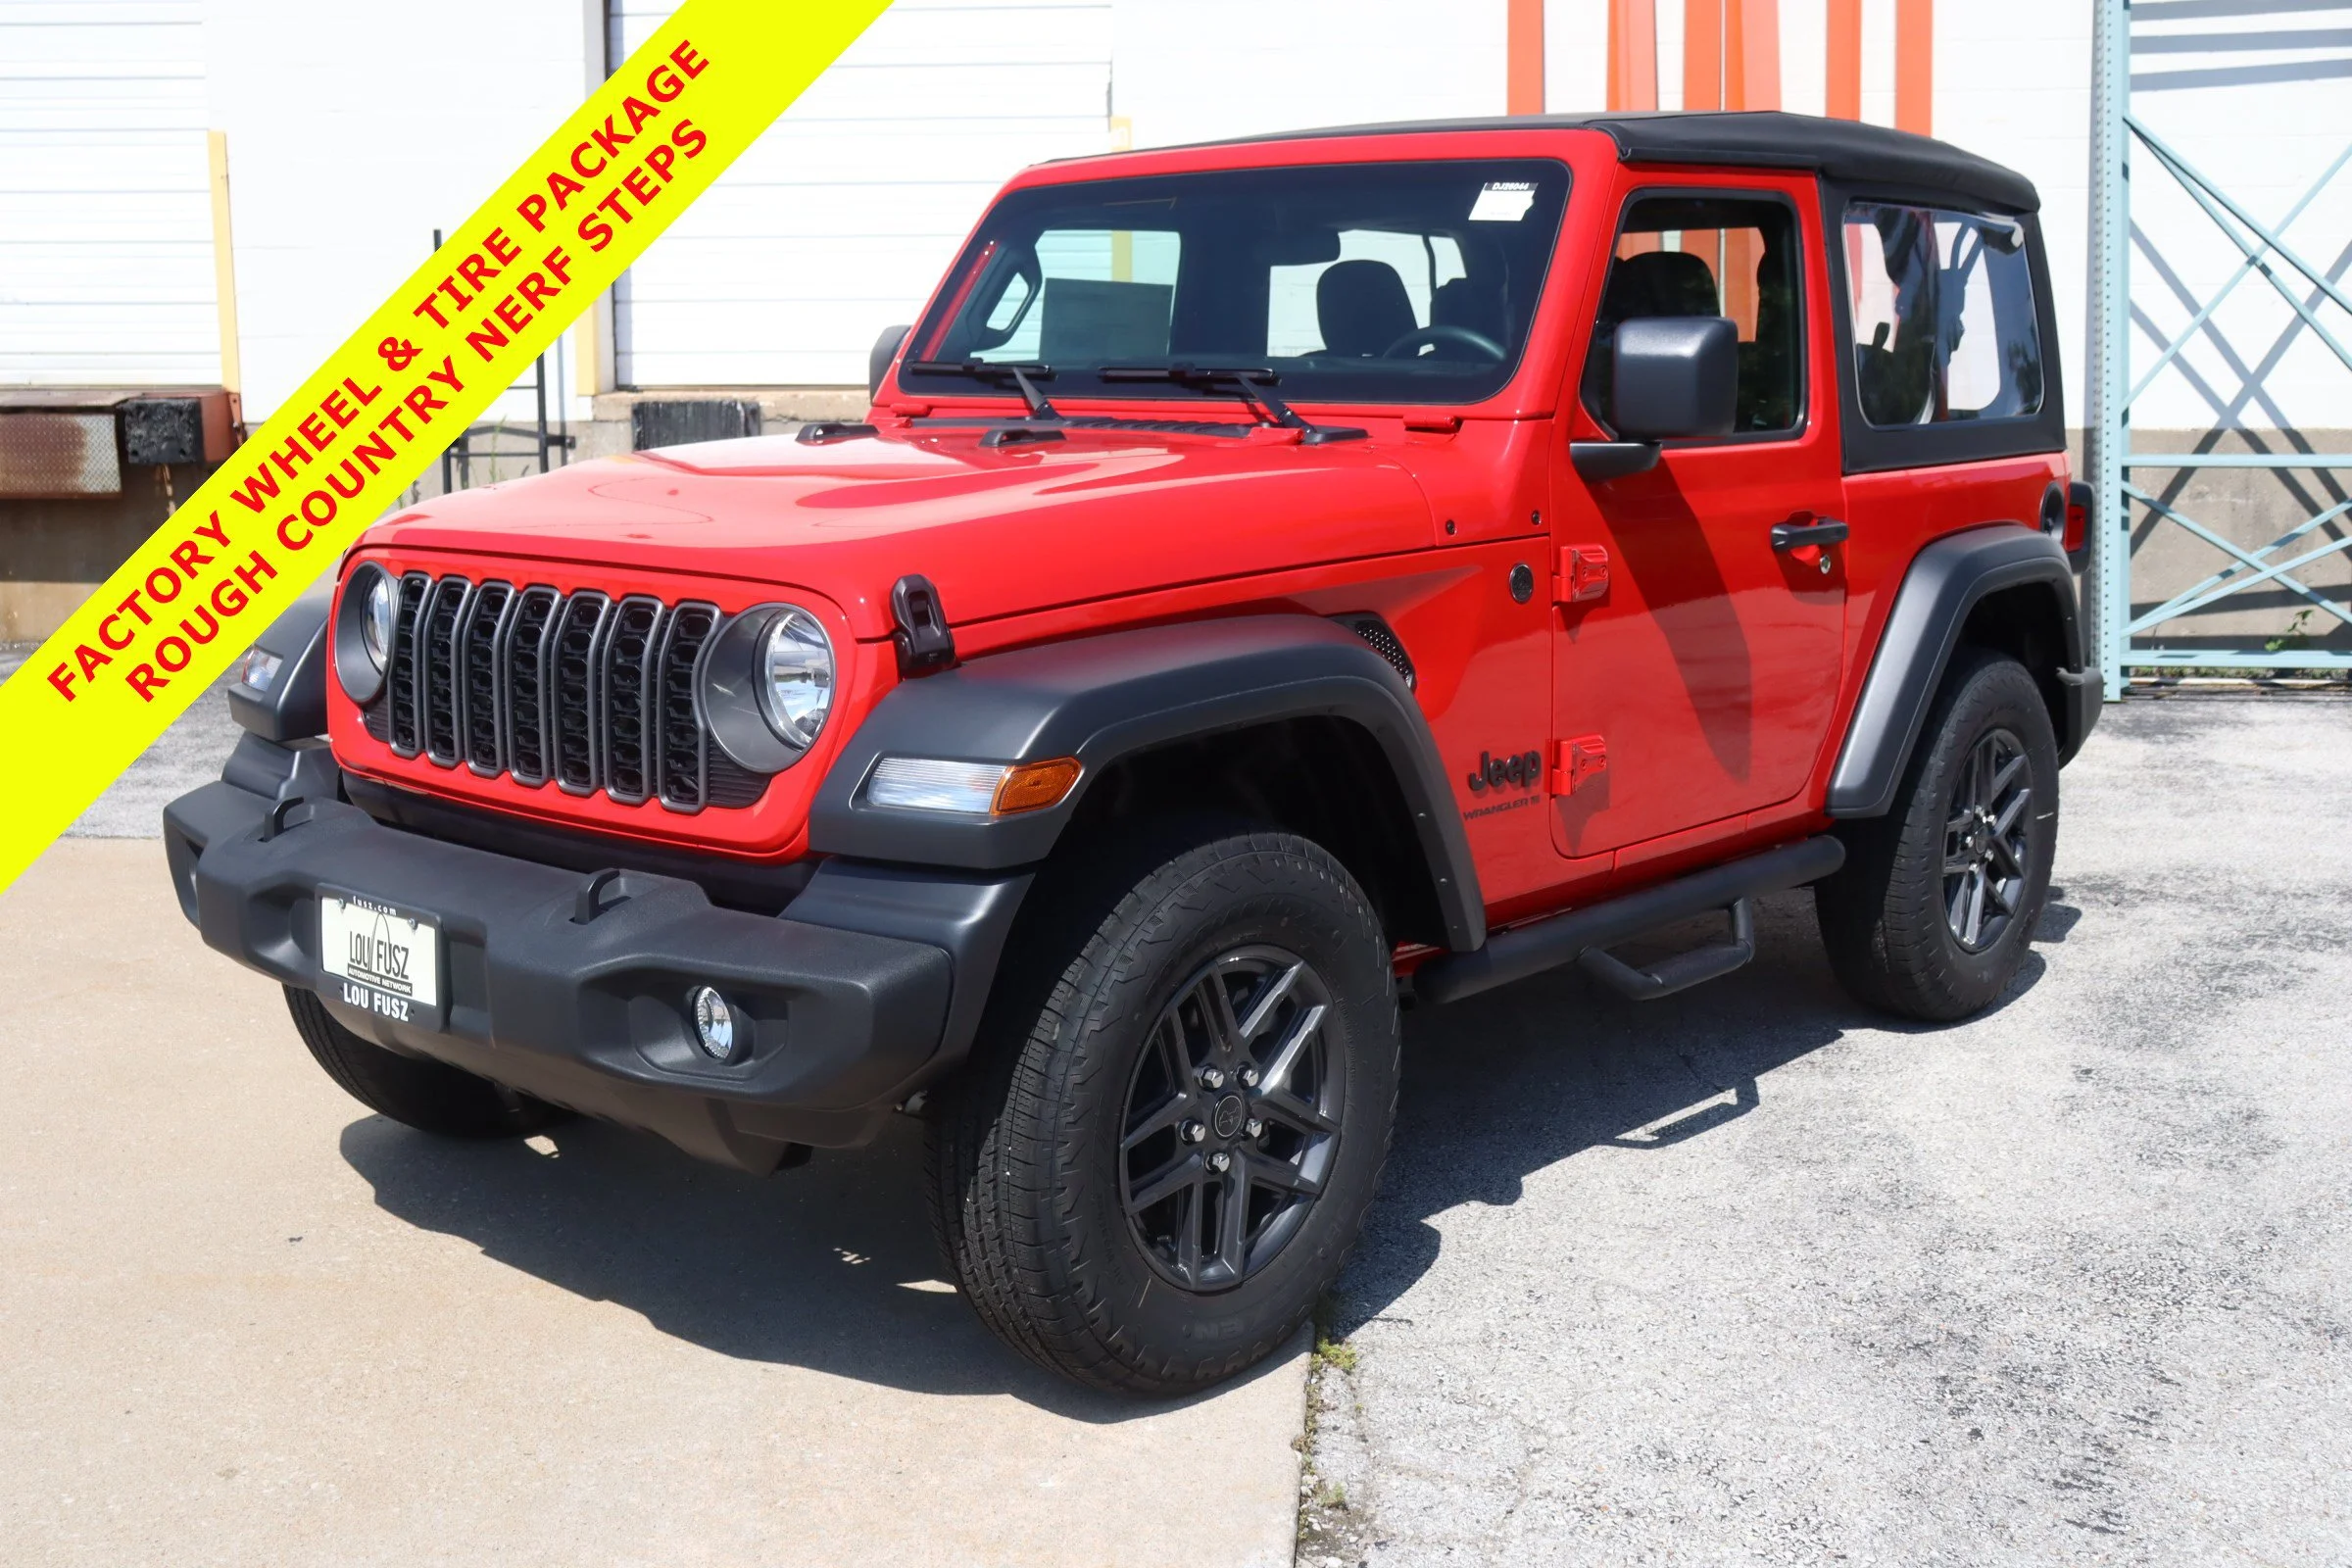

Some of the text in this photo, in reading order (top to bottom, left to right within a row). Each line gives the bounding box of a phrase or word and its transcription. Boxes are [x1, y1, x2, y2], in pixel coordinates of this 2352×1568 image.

[1468, 751, 1542, 791] Jeep
[1463, 798, 1529, 821] WRANGLER
[353, 896, 397, 915] fusz.com
[350, 931, 410, 980] LOU FUSZ
[348, 967, 412, 993] AUTOMOTIVE NETWORK
[343, 983, 410, 1022] LOU FUSZ
